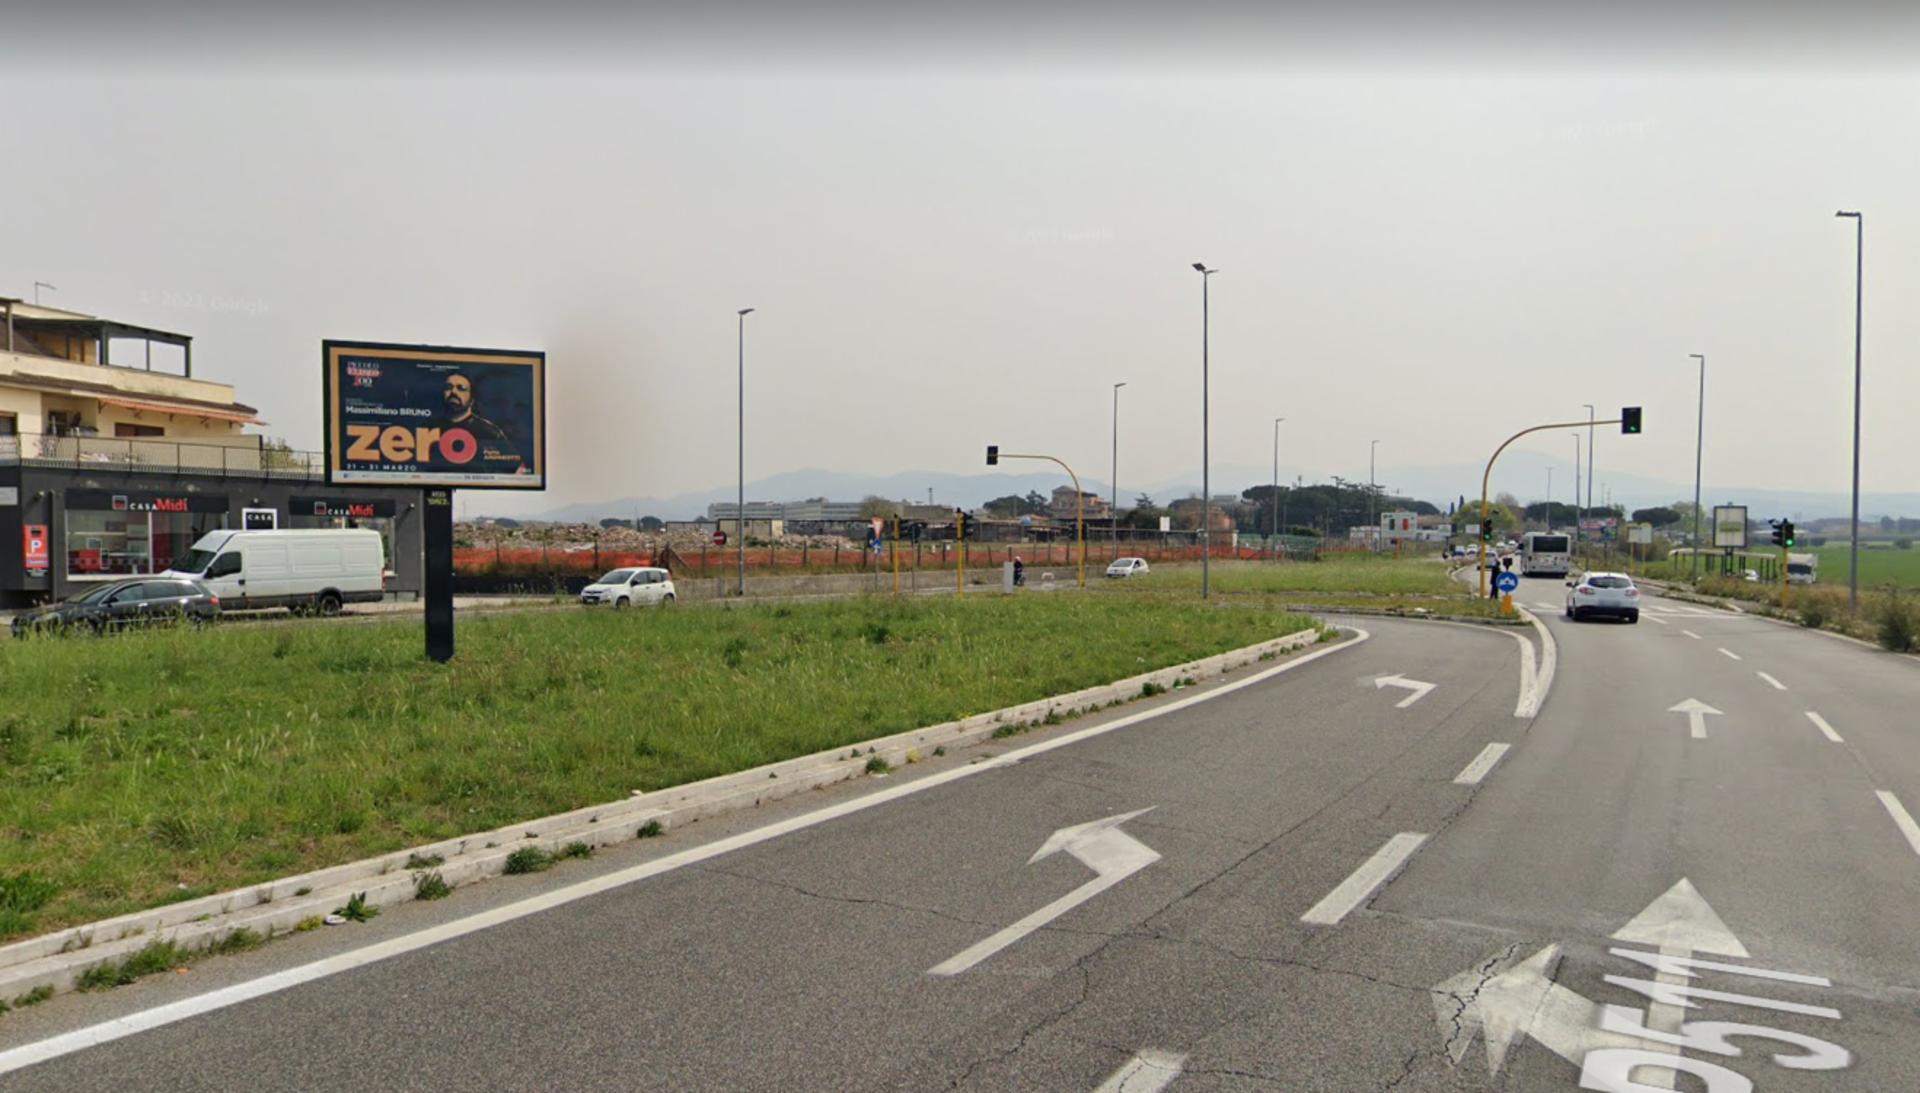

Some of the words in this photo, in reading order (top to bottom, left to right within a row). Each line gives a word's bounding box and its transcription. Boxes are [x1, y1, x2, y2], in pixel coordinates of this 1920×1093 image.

[345, 406, 399, 416] Massimiliano
[399, 407, 432, 417] BRUNO
[346, 425, 478, 464] zero
[383, 464, 417, 472] MARZO
[247, 513, 272, 521] CASA
[31, 540, 42, 553] P
